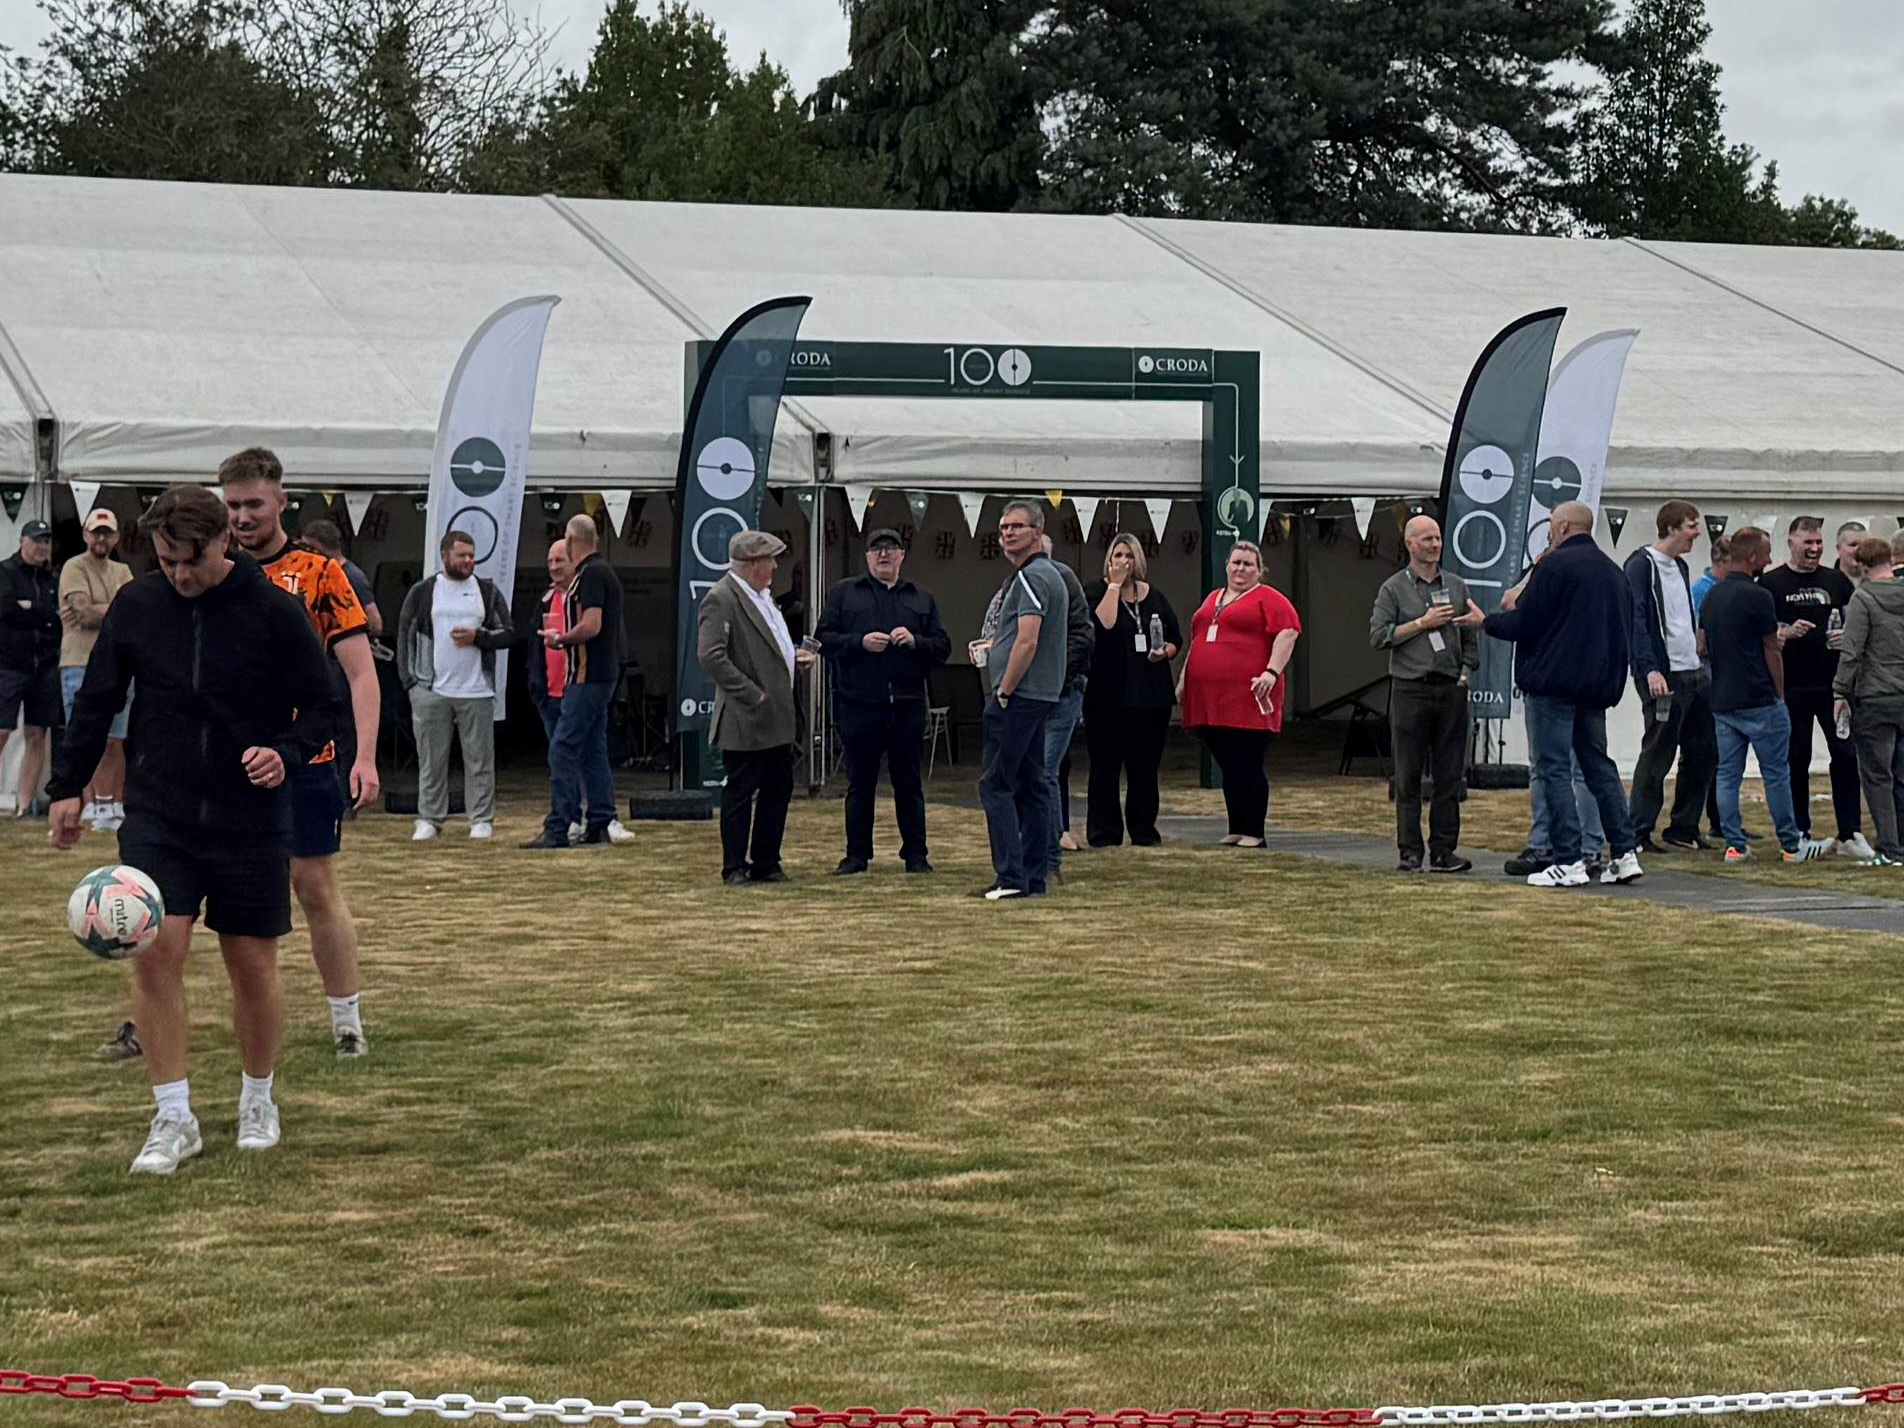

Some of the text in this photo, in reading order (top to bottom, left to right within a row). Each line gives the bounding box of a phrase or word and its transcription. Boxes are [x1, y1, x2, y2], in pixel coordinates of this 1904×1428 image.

[944, 347, 1032, 386] 100
[1156, 358, 1208, 372] CRODA
[115, 898, 129, 935] mitre
